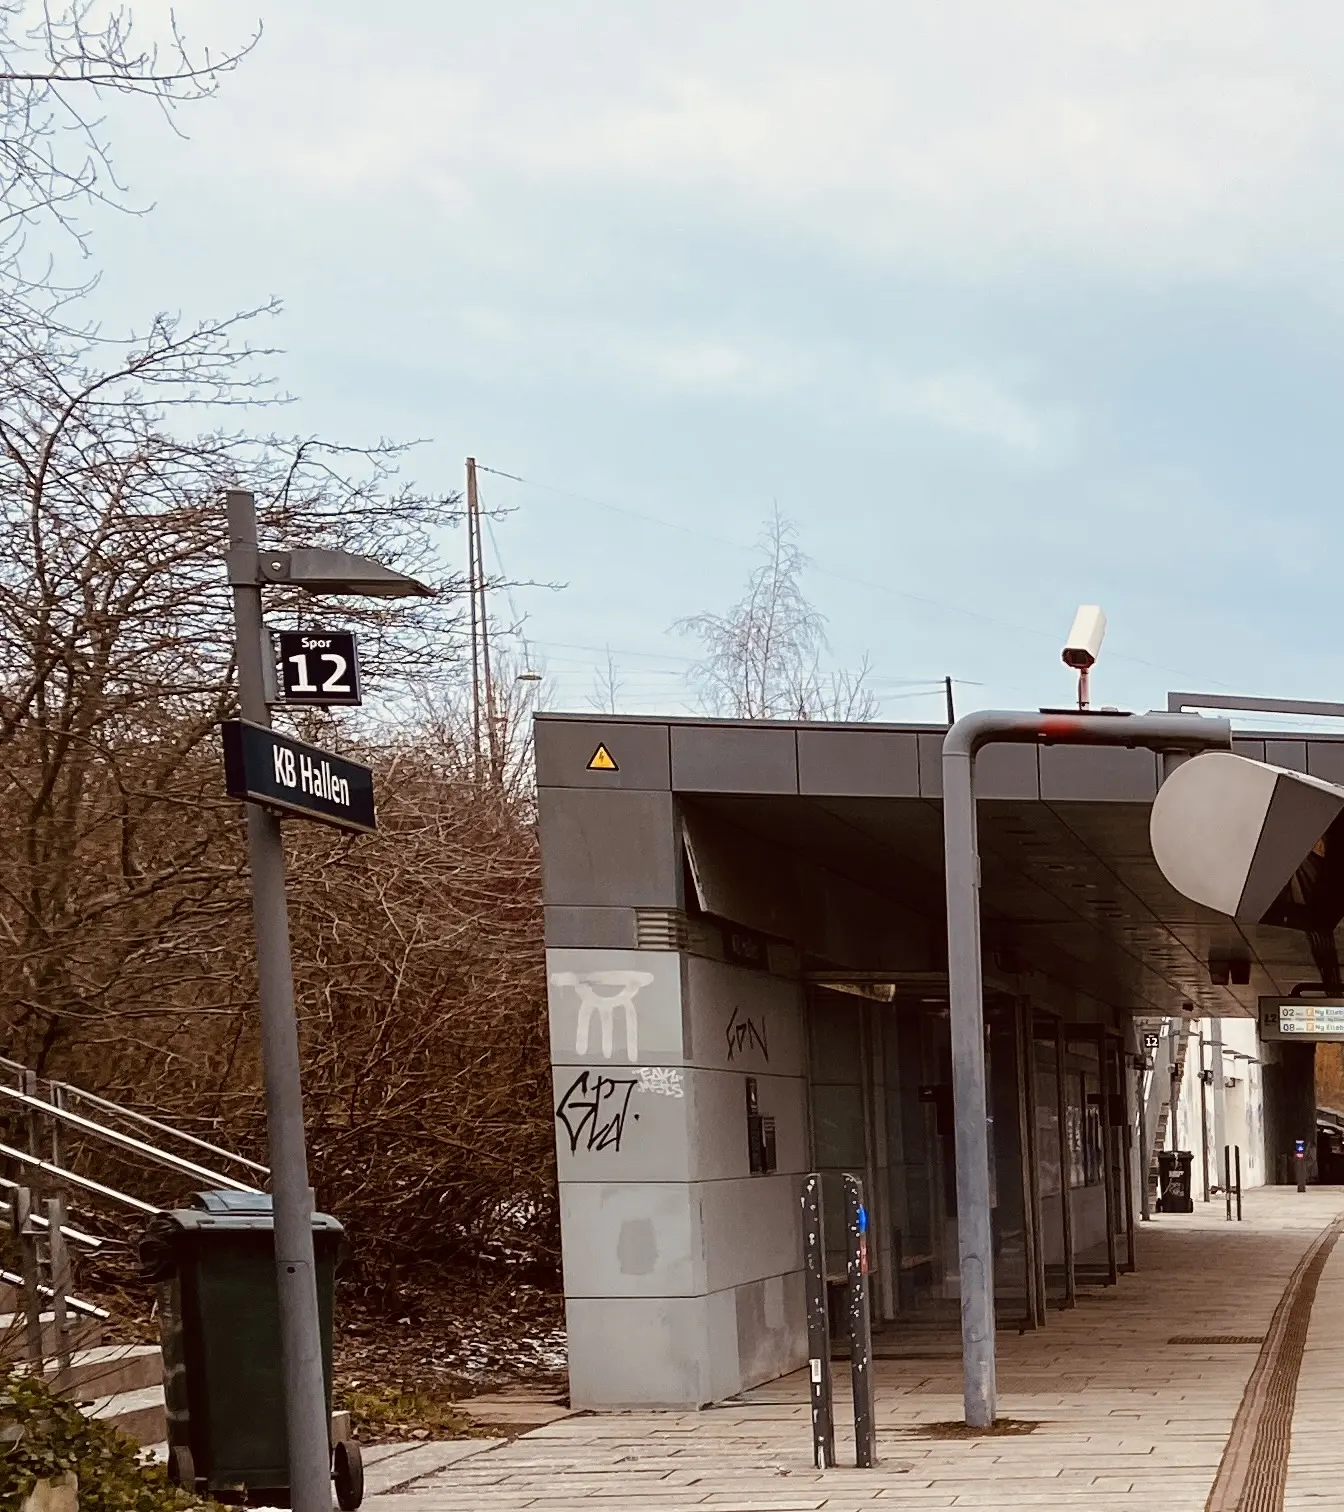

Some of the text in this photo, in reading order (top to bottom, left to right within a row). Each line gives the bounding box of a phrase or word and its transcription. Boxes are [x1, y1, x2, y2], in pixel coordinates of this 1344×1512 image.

[301, 637, 332, 650] Spor
[288, 653, 351, 693] 12
[272, 744, 350, 807] KB Hallen
[1146, 1037, 1158, 1047] 12
